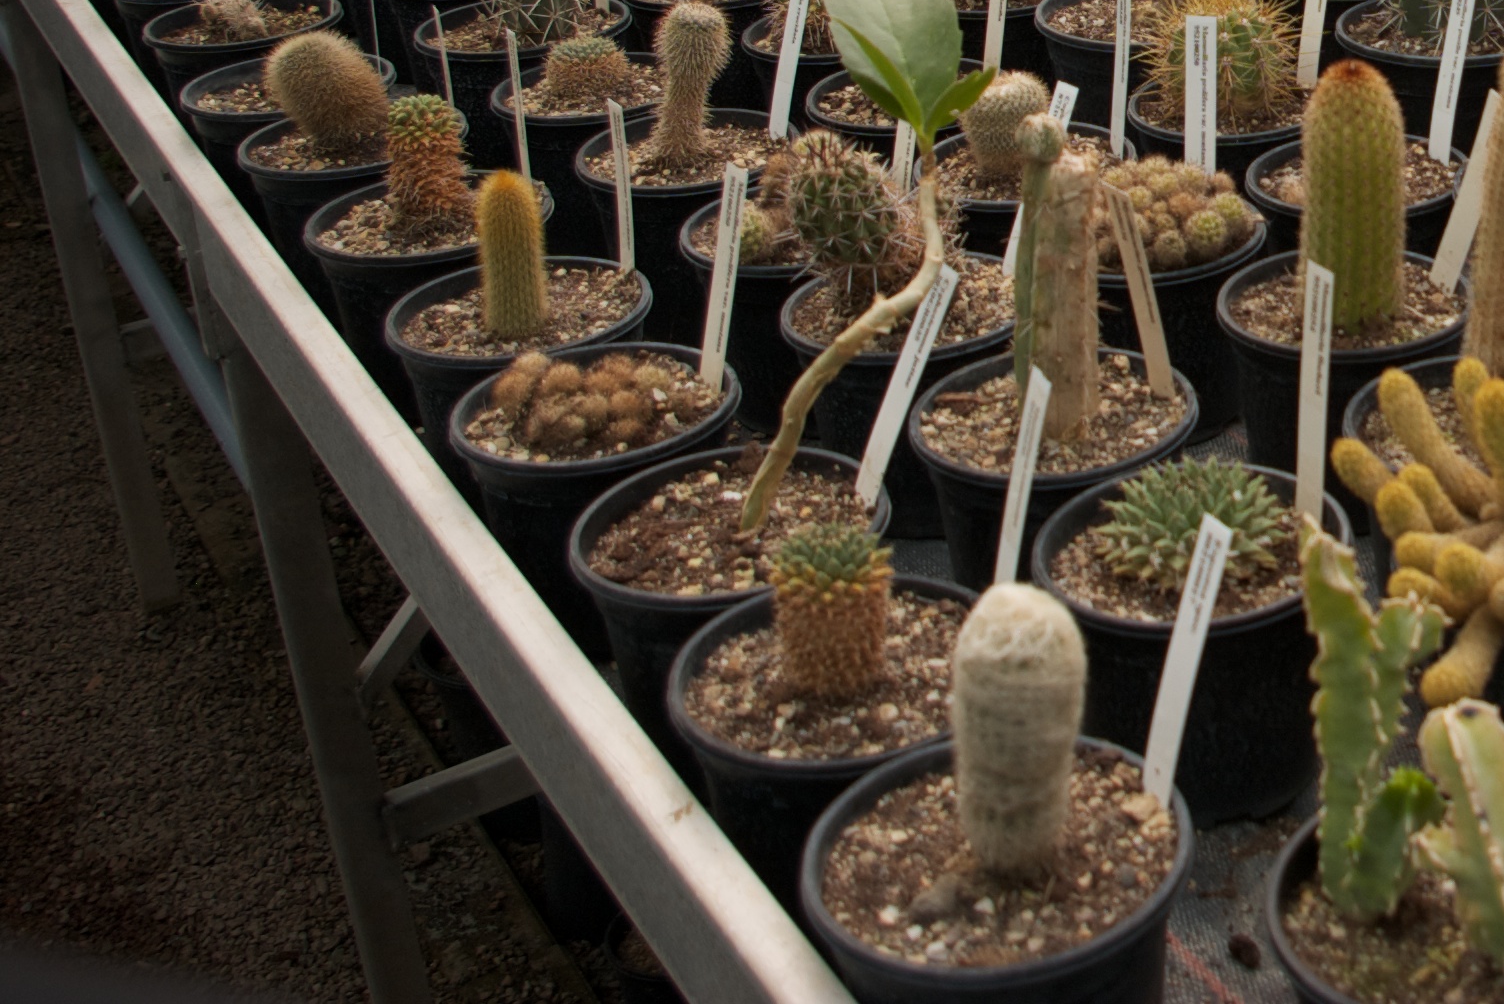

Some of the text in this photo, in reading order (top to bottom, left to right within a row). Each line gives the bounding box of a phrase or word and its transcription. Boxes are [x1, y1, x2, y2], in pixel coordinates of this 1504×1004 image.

[730, 179, 744, 244] Mammillaria
[723, 244, 736, 290] prolifera
[721, 289, 730, 310] var.
